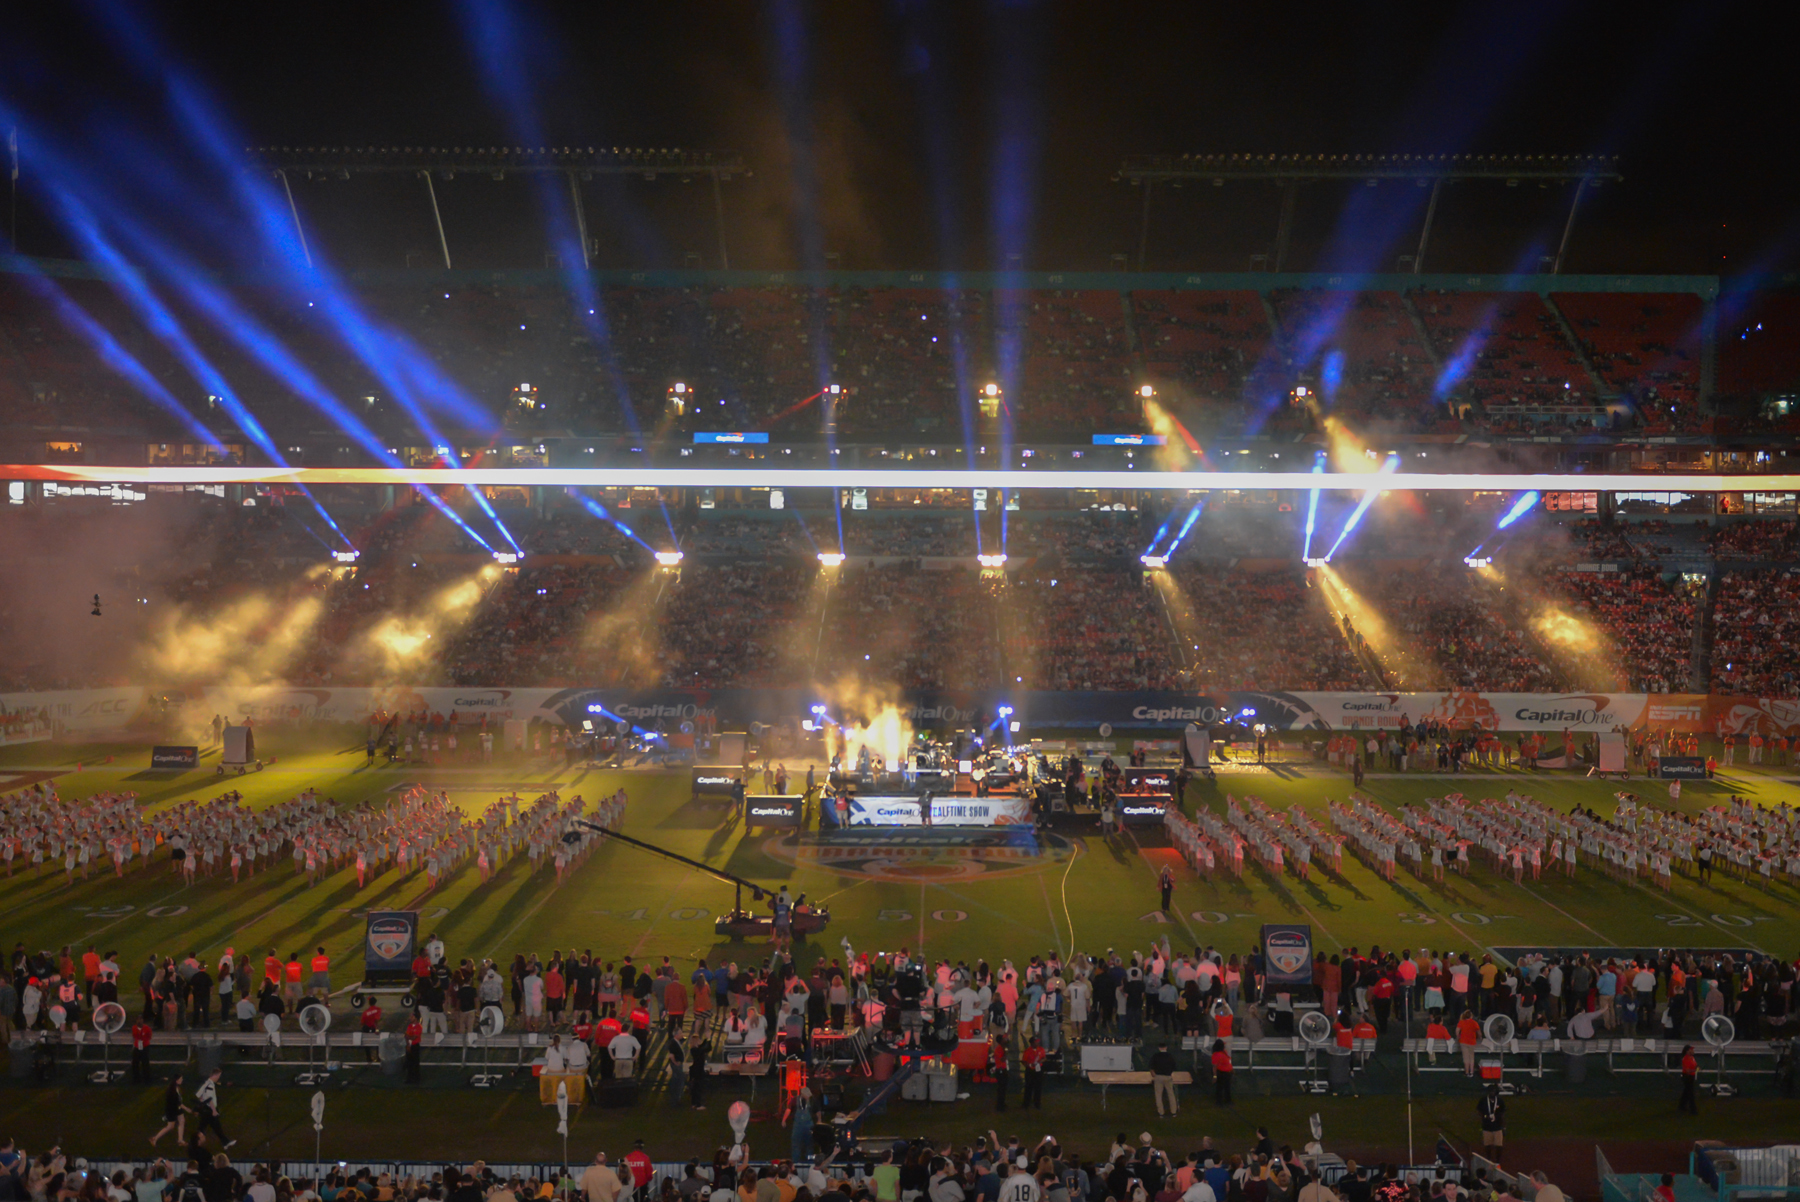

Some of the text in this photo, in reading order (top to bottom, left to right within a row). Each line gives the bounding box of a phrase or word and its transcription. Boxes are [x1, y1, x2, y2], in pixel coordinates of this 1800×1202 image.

[80, 699, 128, 715] ACC
[1649, 705, 1702, 720] ESPN
[1015, 1184, 1031, 1201] 18
